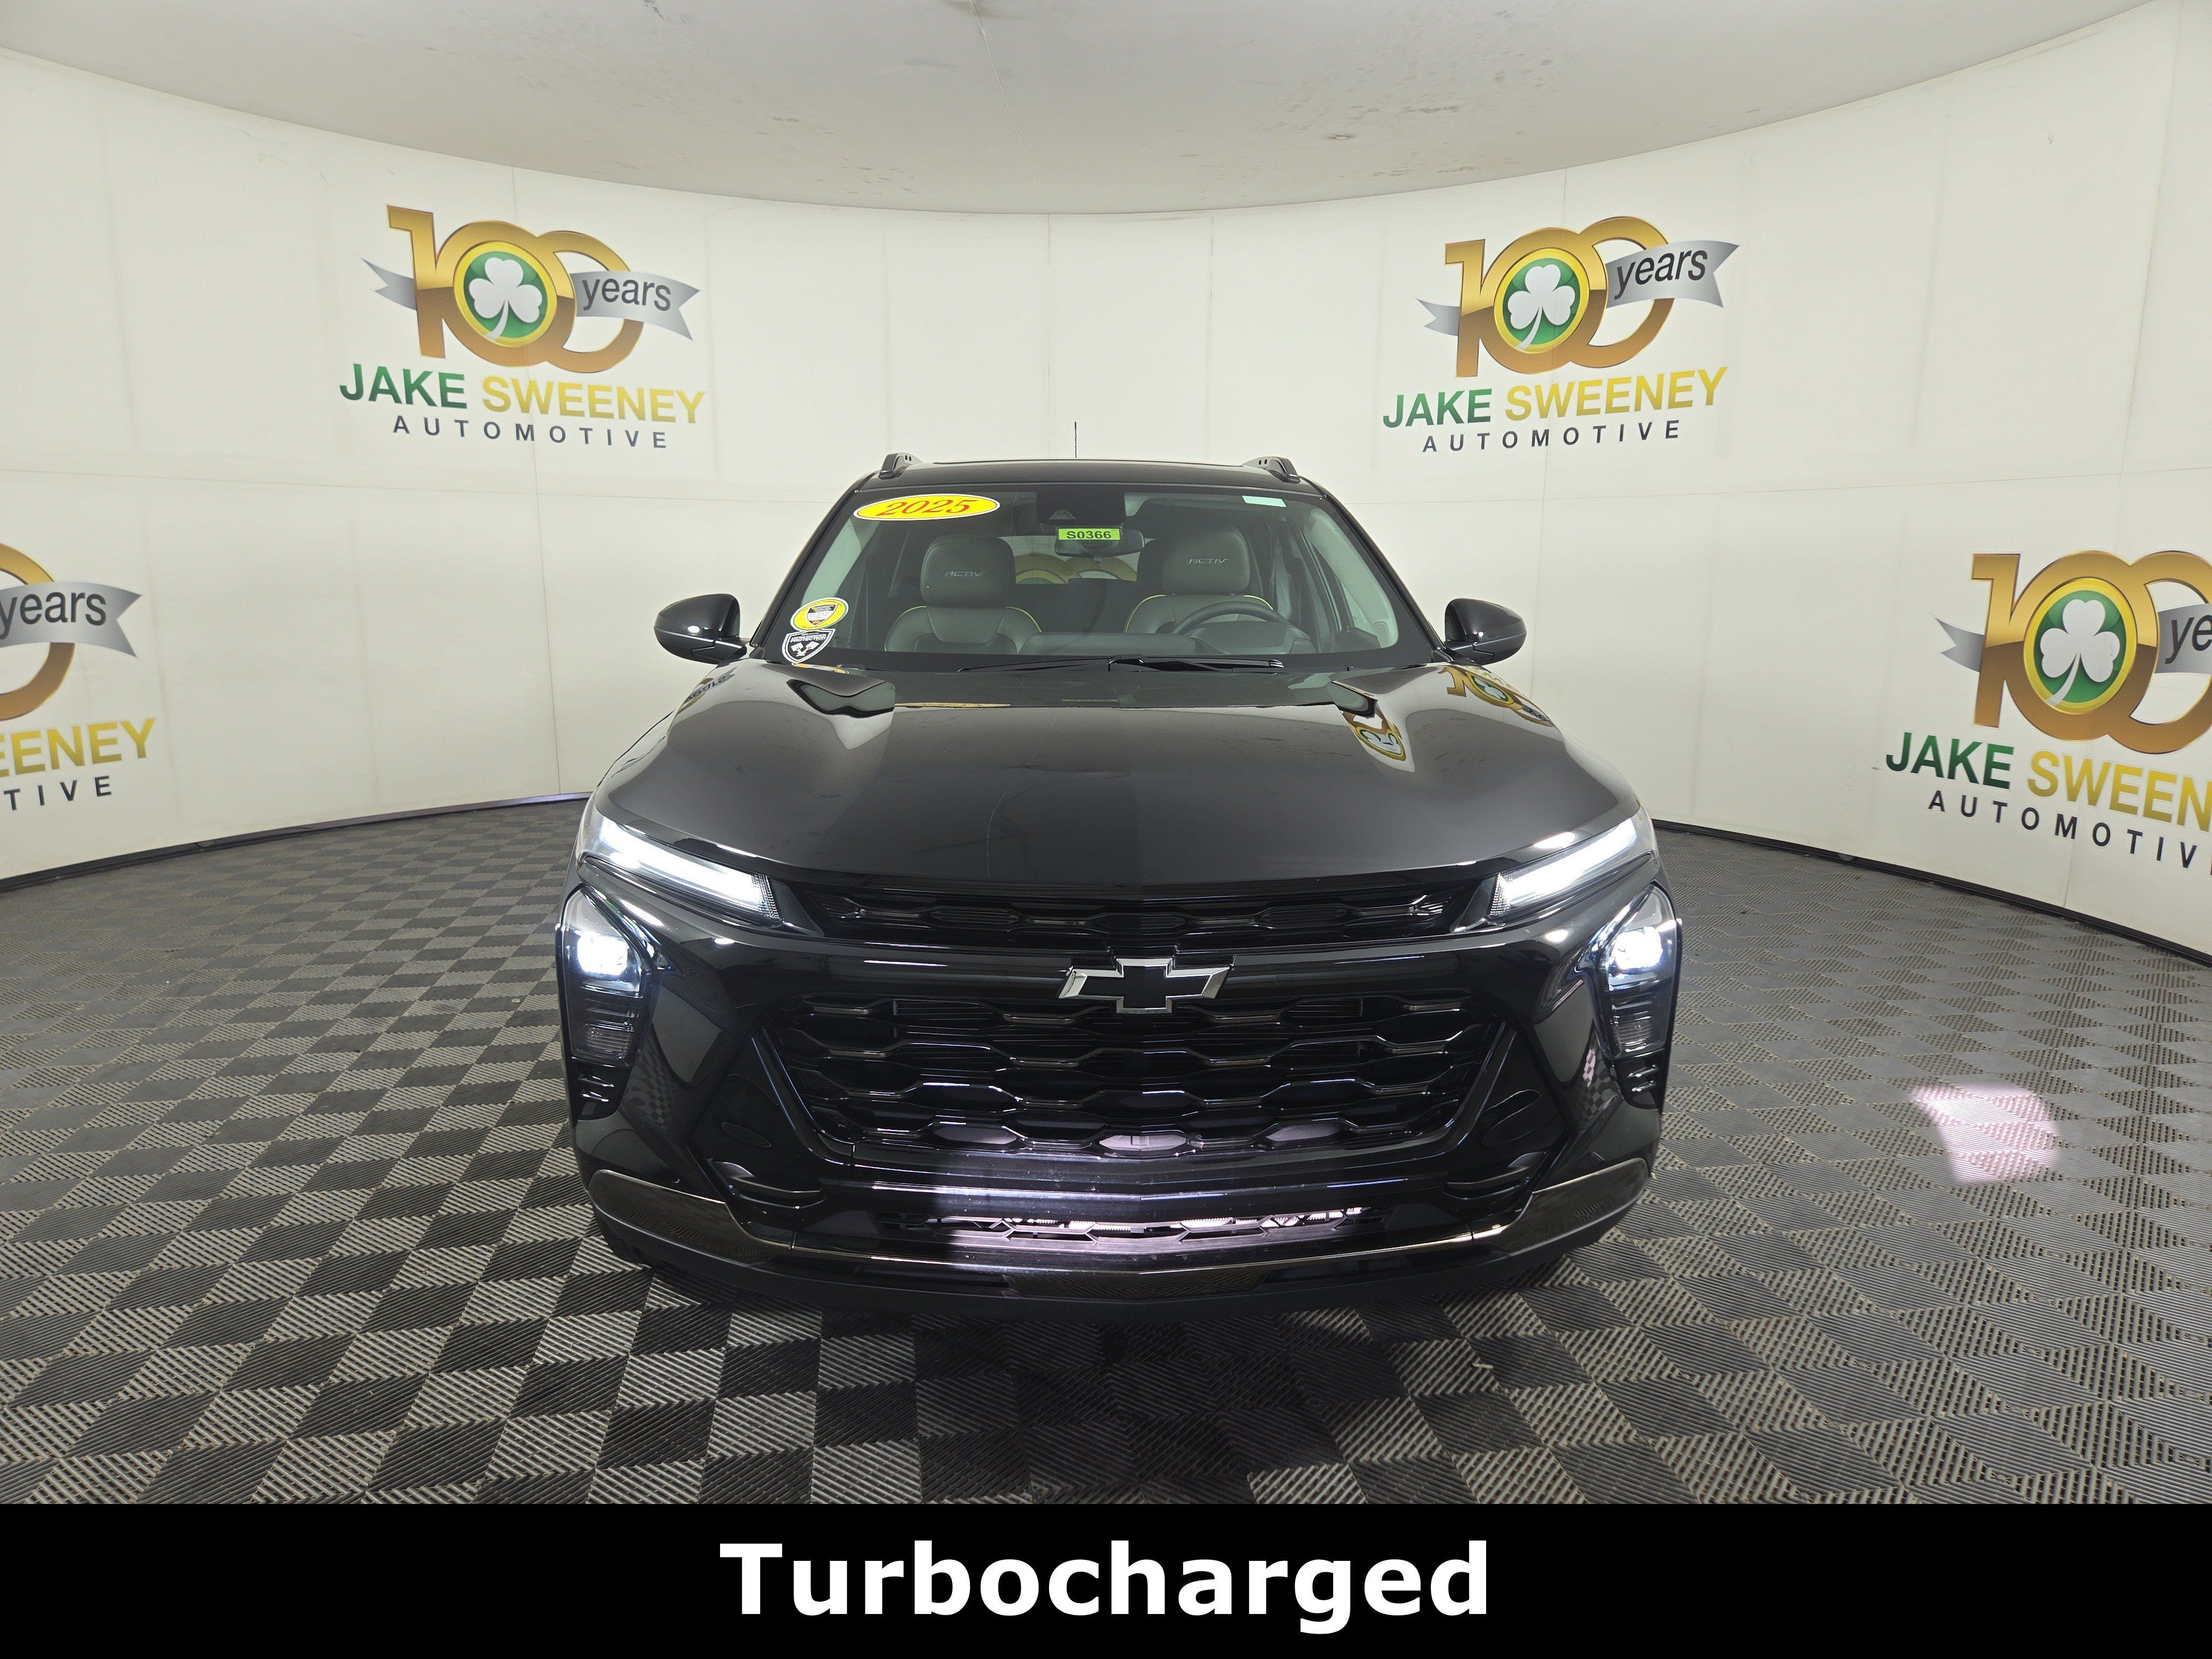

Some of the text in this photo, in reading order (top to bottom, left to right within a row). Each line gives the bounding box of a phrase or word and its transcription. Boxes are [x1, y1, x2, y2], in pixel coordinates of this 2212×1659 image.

[387, 204, 672, 374] 100 years
[1445, 216, 1708, 378] 100 years
[339, 363, 706, 425] JAKE SWEENEY
[1382, 366, 1728, 428] JAKE SWEENEY
[393, 415, 666, 449] AUTOMOTIVE
[1422, 420, 1680, 453] AUTOMOTIVE
[875, 499, 979, 517] 2025
[1066, 531, 1112, 539] S0366
[4, 775, 112, 811] TIVE
[1886, 732, 2212, 833] JAKE SWEEN
[1928, 790, 2212, 876] AUTOMOTIV
